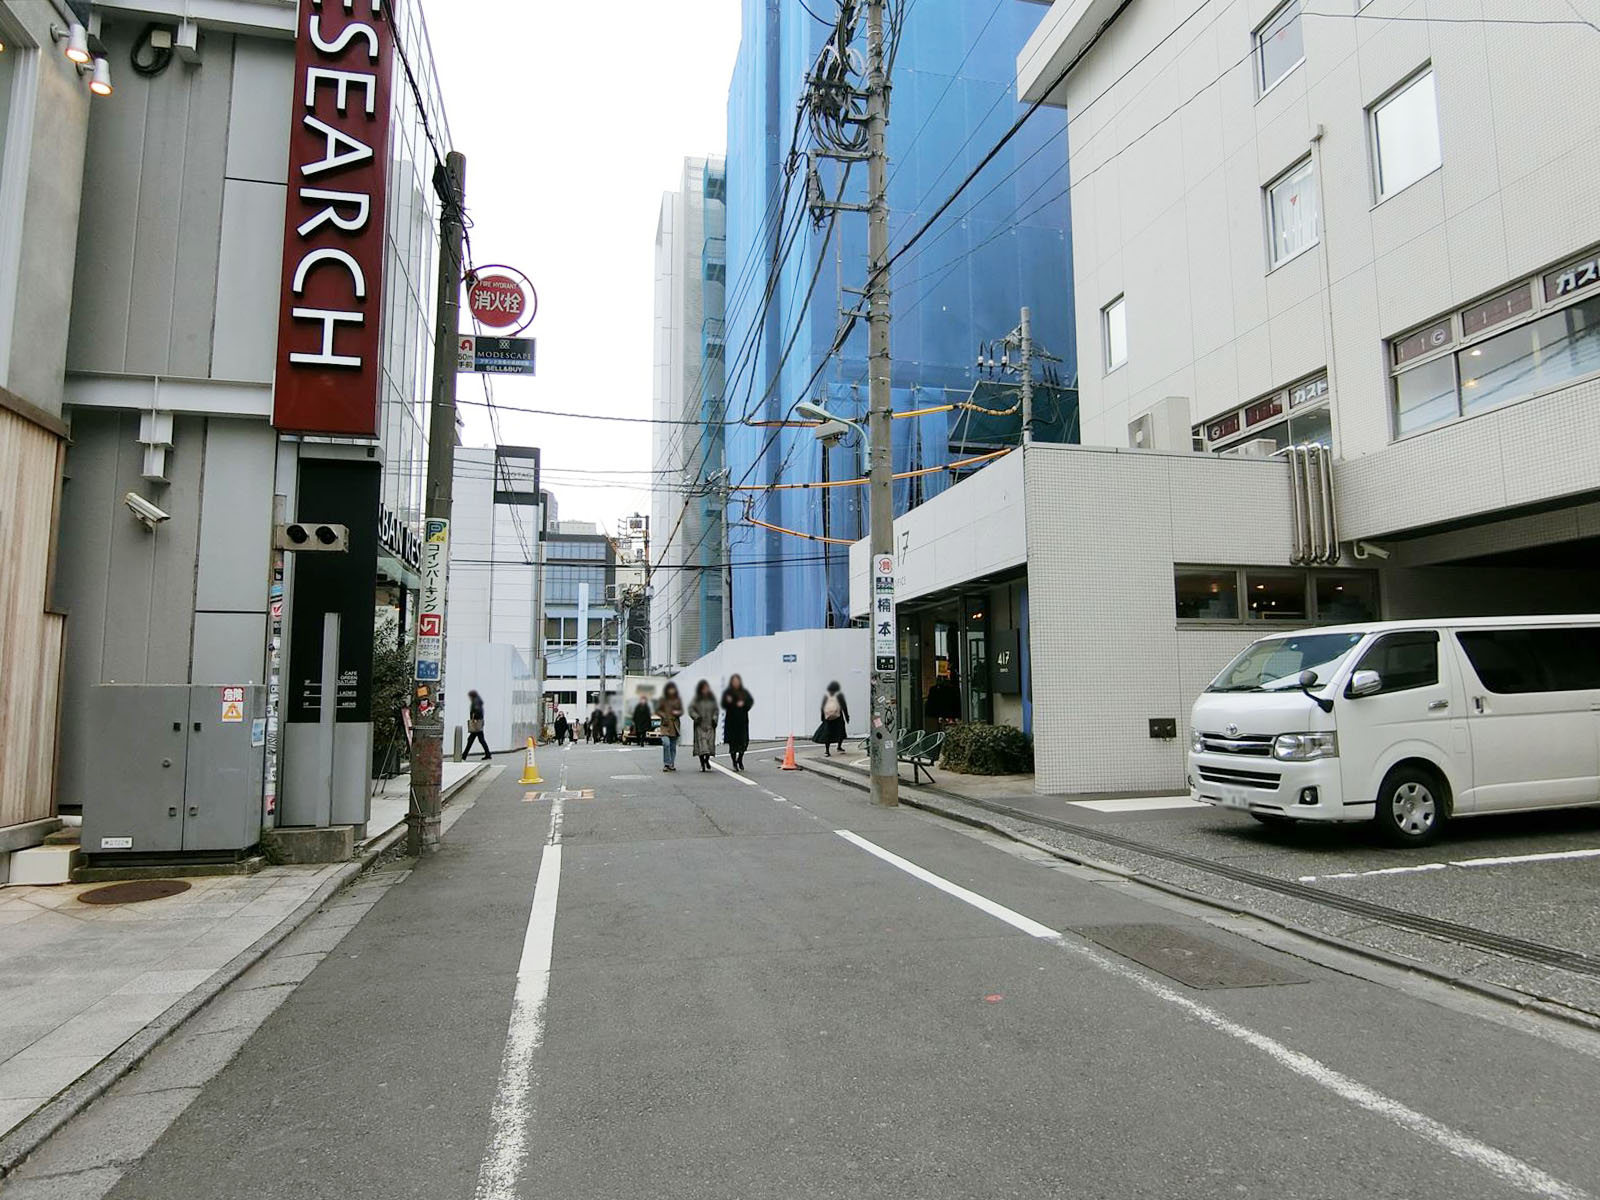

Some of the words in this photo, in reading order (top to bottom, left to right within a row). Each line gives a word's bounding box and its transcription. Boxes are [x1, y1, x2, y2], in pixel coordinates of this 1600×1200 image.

[289, 0, 381, 366] SEARCH
[479, 280, 492, 288] FIRE
[492, 281, 517, 289] HYDRANT
[1556, 256, 1600, 295] ガス
[473, 290, 522, 314] 消火栓
[477, 352, 532, 360] MODESCAPE
[485, 365, 524, 373] SELL&BUY
[423, 543, 441, 613] コインパーキング
[878, 597, 892, 637] 楠本
[997, 651, 1010, 666] 417
[223, 687, 244, 702] 危険
